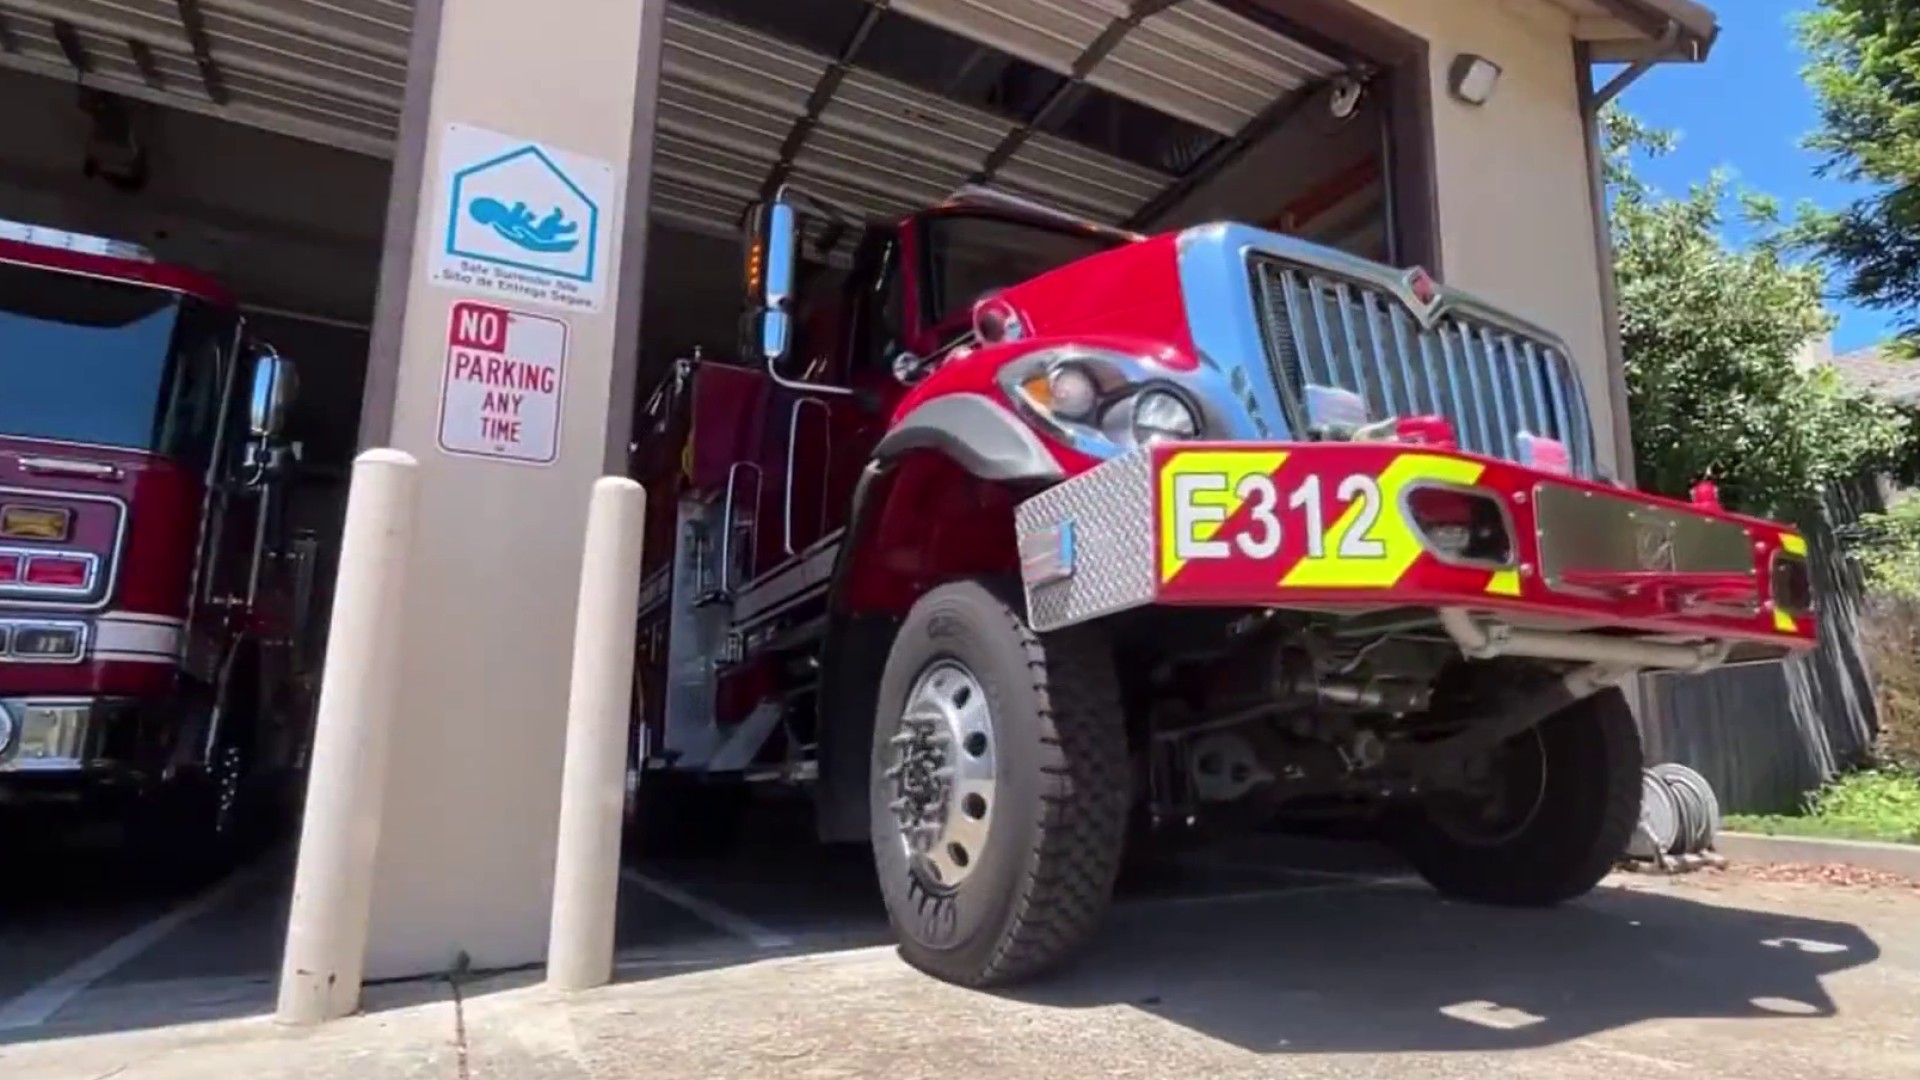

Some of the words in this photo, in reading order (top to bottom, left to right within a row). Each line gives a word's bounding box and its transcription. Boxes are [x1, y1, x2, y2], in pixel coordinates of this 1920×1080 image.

[442, 268, 472, 284] Sitio
[477, 277, 493, 288] de
[498, 280, 546, 299] Entrega
[458, 309, 499, 344] NO
[454, 353, 555, 393] PARKING
[481, 391, 522, 415] ANY
[480, 417, 521, 442] TIME
[1174, 472, 1387, 559] E312
